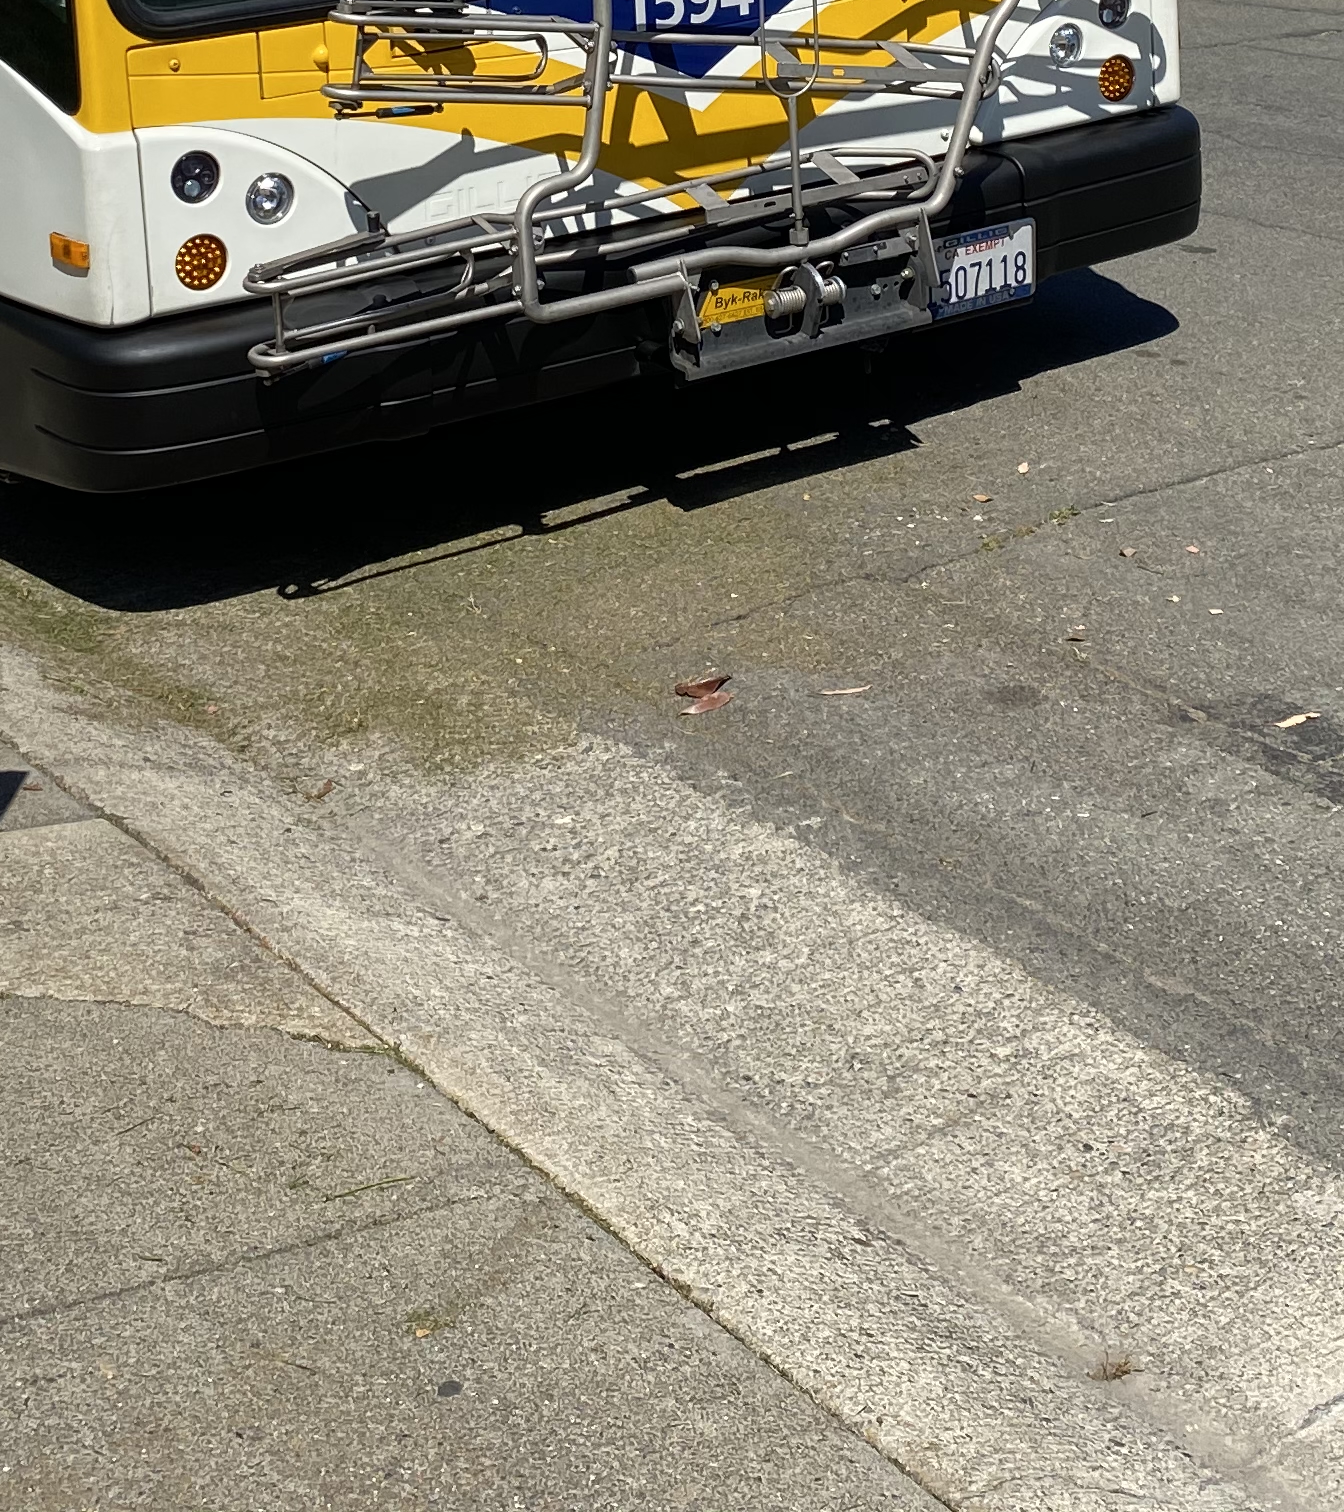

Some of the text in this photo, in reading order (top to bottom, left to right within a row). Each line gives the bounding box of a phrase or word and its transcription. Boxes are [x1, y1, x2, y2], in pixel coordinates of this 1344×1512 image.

[944, 239, 1006, 261] CA EXEMPT
[943, 289, 1010, 315] MADE IN USA
